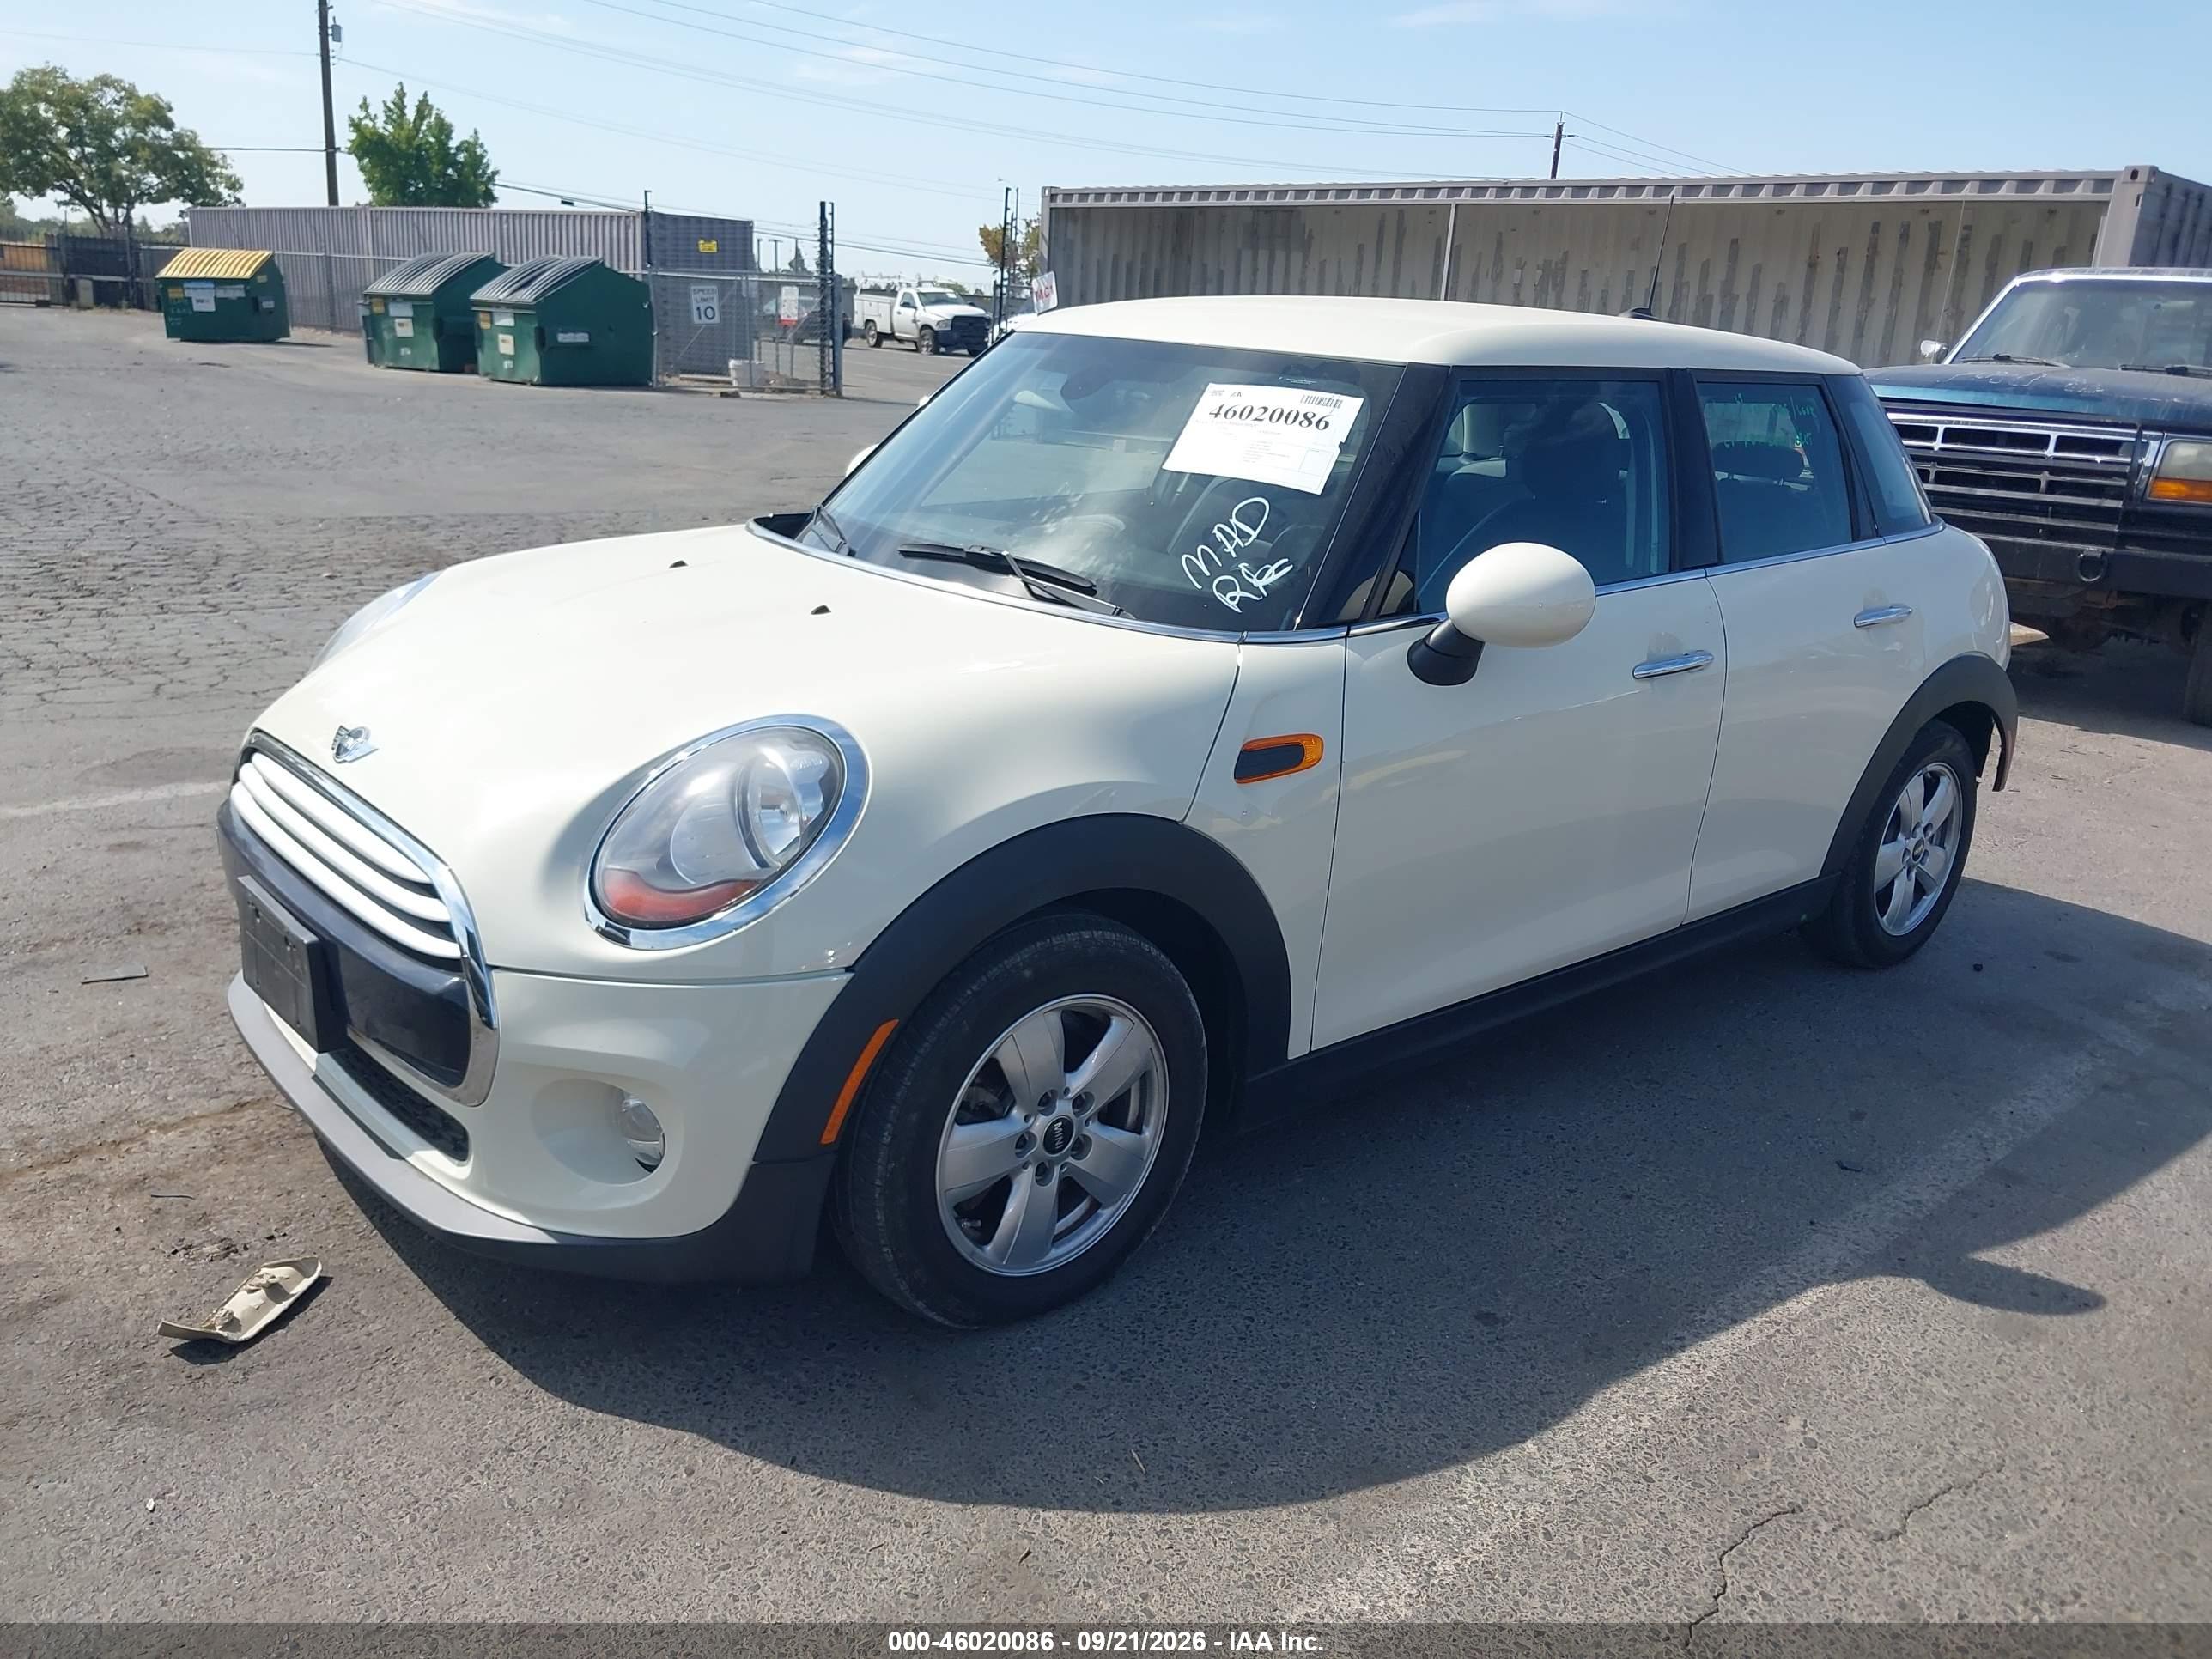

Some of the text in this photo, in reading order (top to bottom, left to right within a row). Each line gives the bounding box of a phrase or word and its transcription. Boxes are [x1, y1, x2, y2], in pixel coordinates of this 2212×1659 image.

[696, 306, 715, 320] 10
[1208, 403, 1334, 431] 46020086
[1054, 1121, 1063, 1149] MINI
